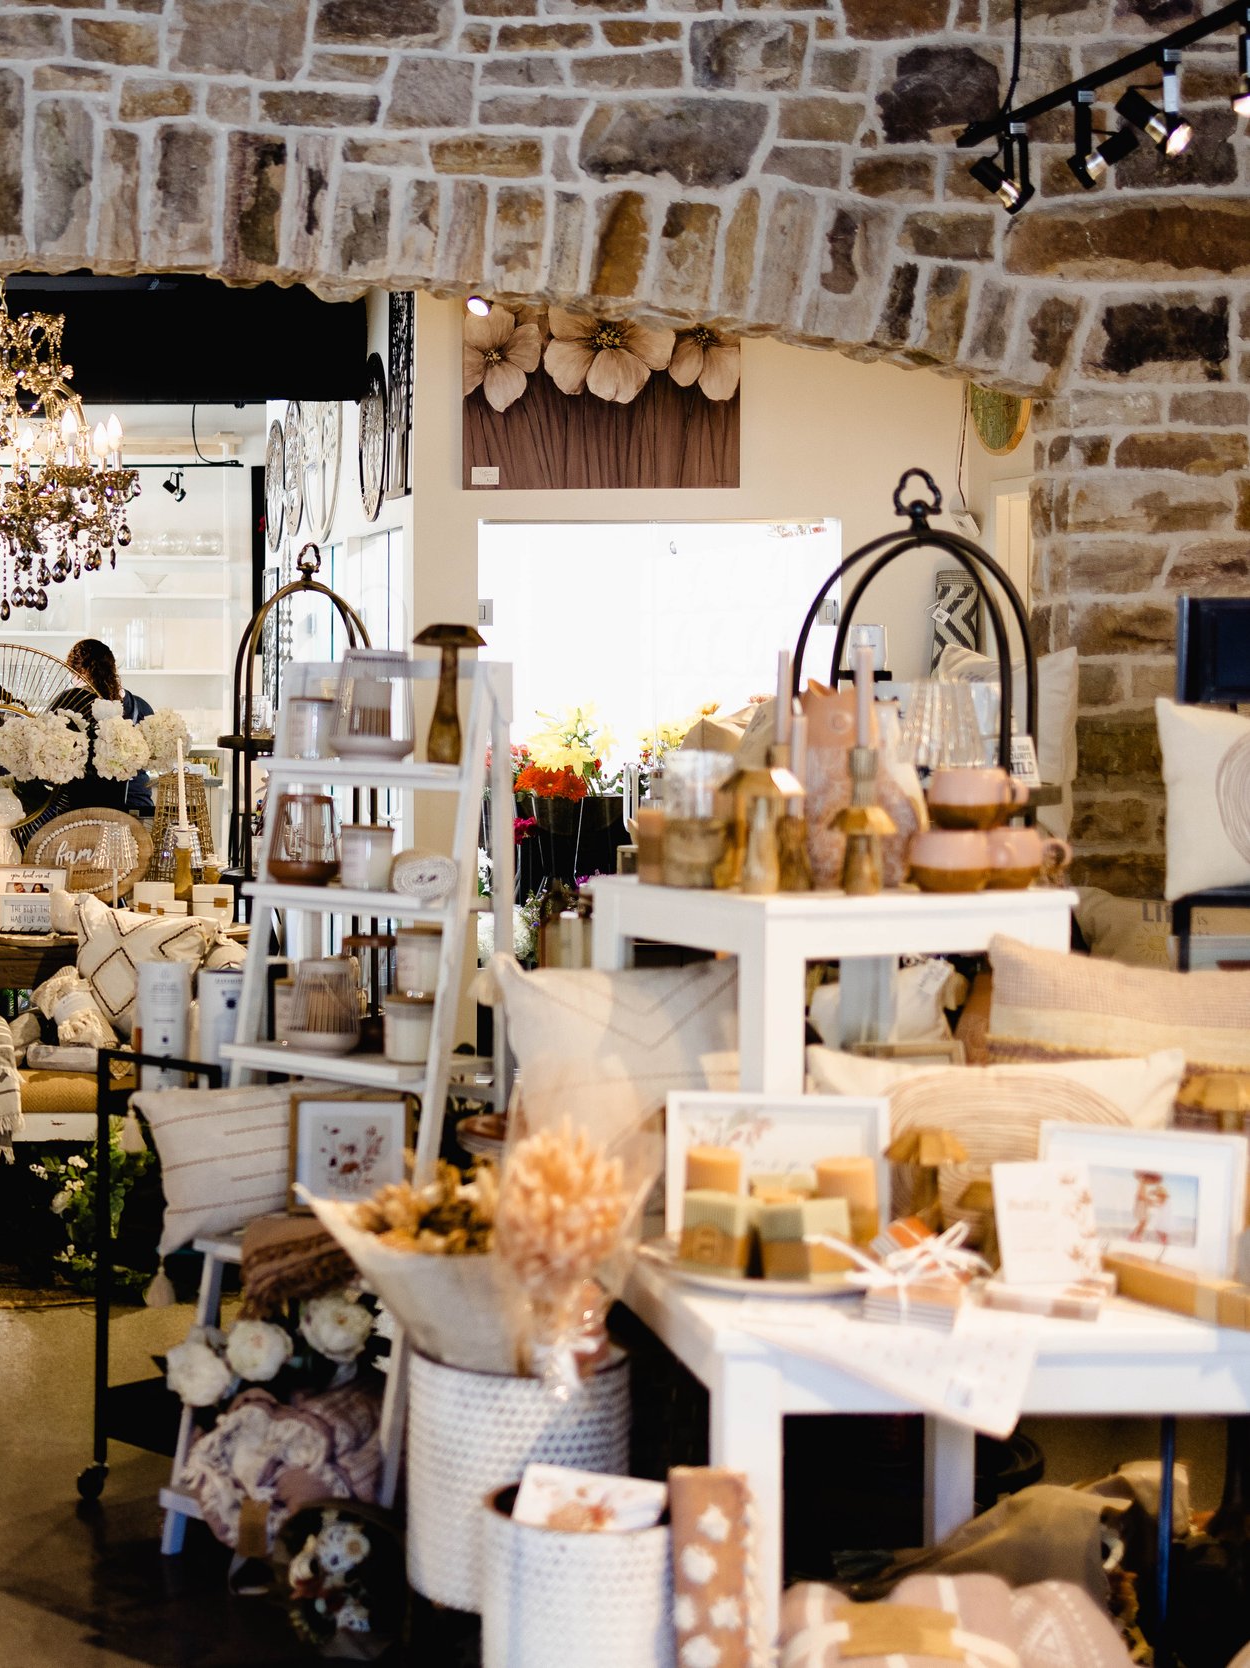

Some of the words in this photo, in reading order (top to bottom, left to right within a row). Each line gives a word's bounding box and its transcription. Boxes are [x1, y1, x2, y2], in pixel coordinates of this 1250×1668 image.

[22, 871, 35, 879] had
[11, 904, 21, 913] THE
[24, 904, 37, 914] BEST
[11, 915, 21, 924] HAS
[24, 915, 35, 923] FUR
